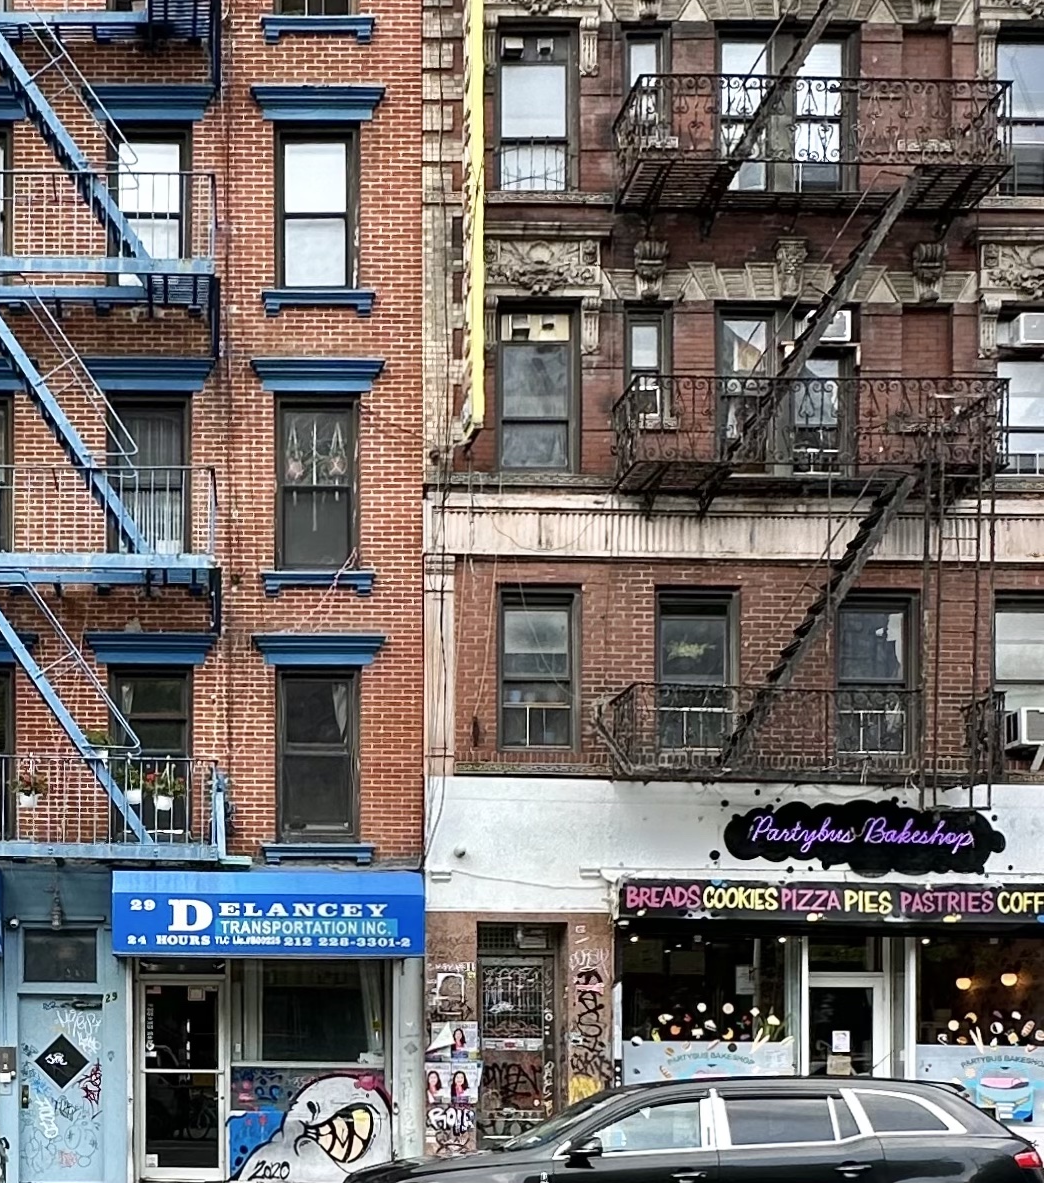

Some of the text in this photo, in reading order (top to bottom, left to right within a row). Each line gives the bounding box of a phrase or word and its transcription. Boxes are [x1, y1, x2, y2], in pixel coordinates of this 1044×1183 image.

[751, 815, 974, 854] Partybus Bakeshop
[129, 899, 156, 911] 29
[625, 884, 701, 909] BREADS
[702, 886, 779, 912] COOKIES
[781, 890, 841, 912] PIZZA
[844, 890, 893, 914] PIES
[900, 890, 994, 914] PASTRIES
[221, 920, 392, 936] TRANSPORTATION INC.
[127, 934, 148, 945] 24
[156, 934, 211, 946] HOURS
[283, 936, 313, 947] 212
[317, 936, 411, 948] 228-3301-2
[105, 991, 118, 1003] 29
[960, 1055, 1003, 1069] PARTYBUS
[248, 1160, 291, 1180] 2020
